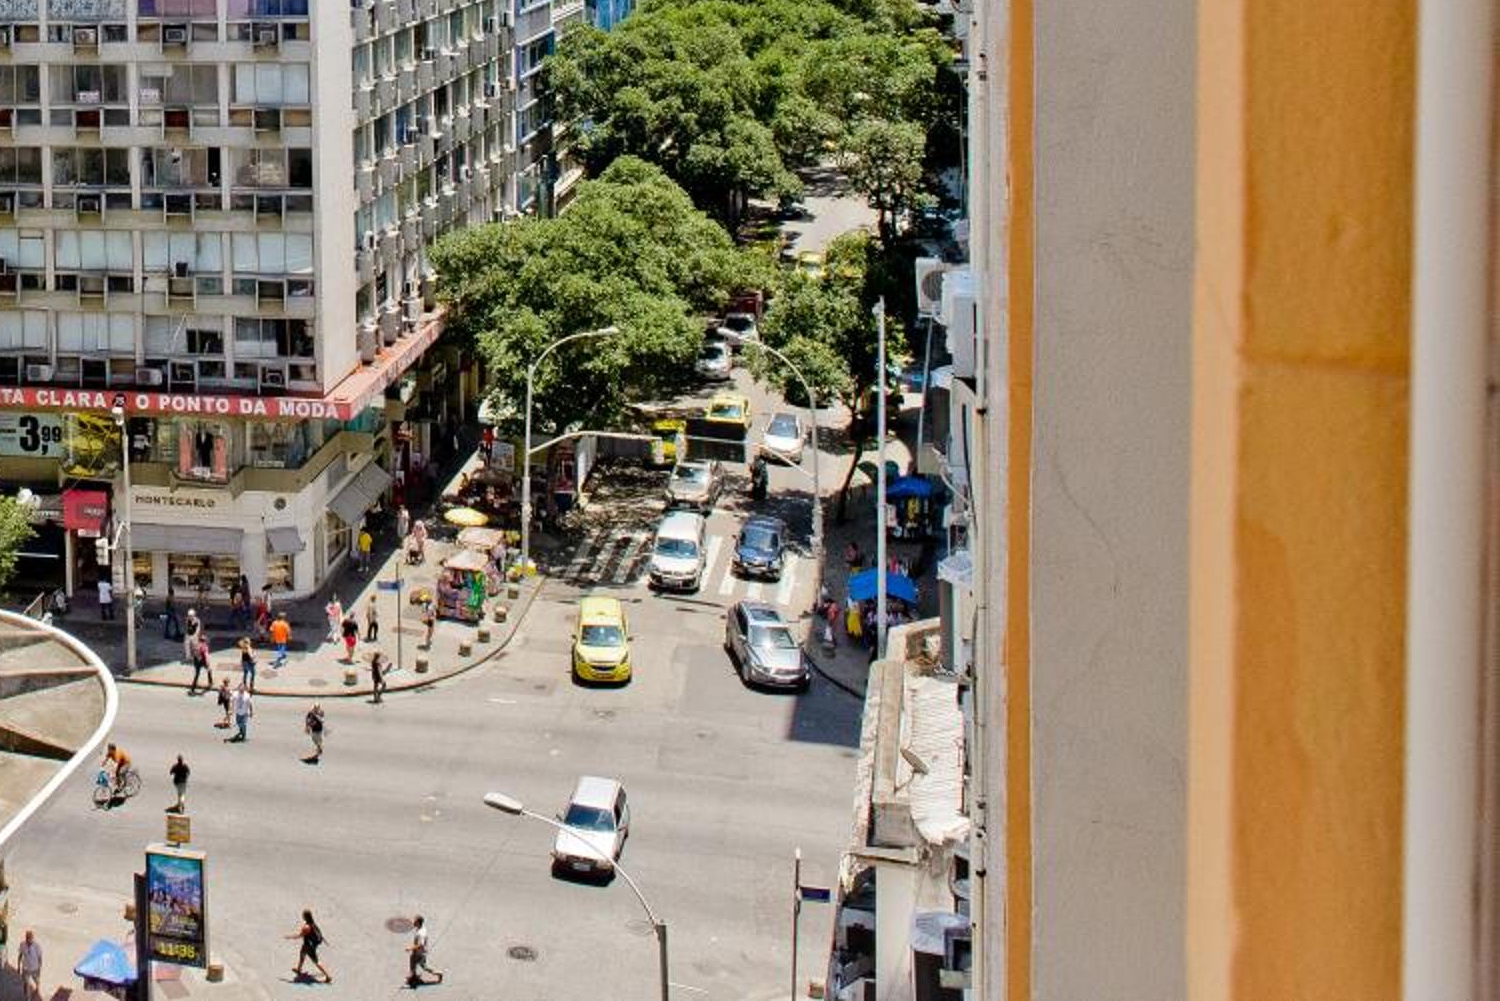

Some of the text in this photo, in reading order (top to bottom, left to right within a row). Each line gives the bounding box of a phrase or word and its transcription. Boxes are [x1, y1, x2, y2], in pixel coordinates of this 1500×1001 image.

[36, 390, 107, 408] CLARA
[135, 393, 150, 410] O
[159, 395, 229, 413] PONTO
[240, 397, 268, 415] DA
[279, 400, 340, 418] MODA
[19, 414, 63, 456] 3,99
[135, 495, 216, 508] MONTECARLO
